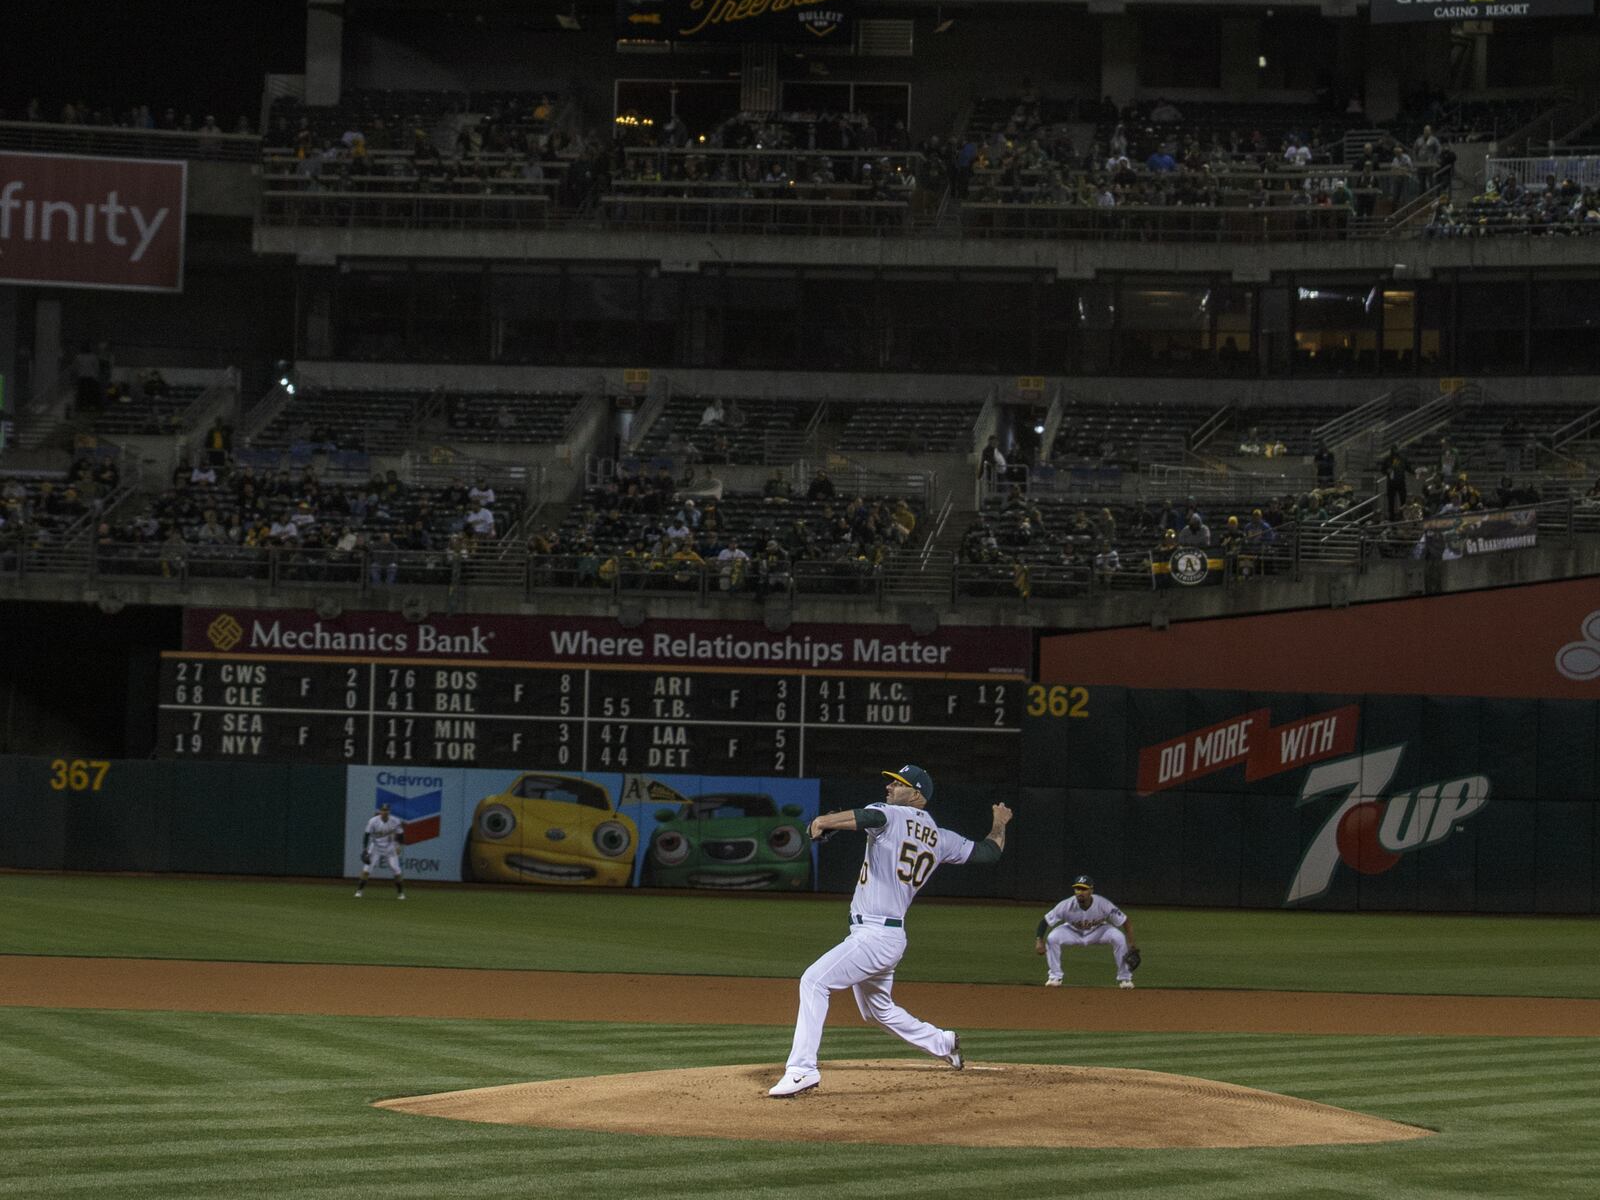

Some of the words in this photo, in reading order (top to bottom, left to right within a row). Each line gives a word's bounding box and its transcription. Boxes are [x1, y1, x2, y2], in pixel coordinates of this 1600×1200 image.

[798, 10, 844, 22] BULLEIT
[1433, 5, 1479, 18] CASINO
[1485, 3, 1530, 16] RESORT
[250, 619, 408, 652] Mechanics
[416, 624, 490, 654] Bank
[550, 629, 645, 657] Where
[653, 632, 843, 668] Relationships
[853, 638, 951, 665] Matter
[220, 665, 267, 683] CWS
[347, 668, 357, 687] 2
[301, 678, 311, 696] F
[435, 670, 478, 690] BOS
[560, 674, 570, 693] 8
[225, 686, 263, 706] CLE
[346, 690, 357, 709] 0
[514, 684, 524, 702] F
[654, 676, 692, 696] ARI
[777, 680, 787, 699] 3
[730, 689, 740, 708] F
[869, 682, 907, 701] K.C.
[435, 693, 476, 712] BAL
[560, 696, 570, 715] 5
[652, 699, 691, 718] T.B.
[776, 702, 786, 721] 6
[947, 695, 957, 714] F
[1026, 684, 1089, 718] 362
[192, 712, 202, 731] 7
[223, 714, 263, 732] SEA
[344, 717, 355, 735] 4
[866, 704, 911, 723] HOU
[994, 707, 1005, 726] 2
[298, 727, 308, 746] F
[434, 720, 476, 739] MIN
[559, 723, 569, 742] 3
[652, 726, 687, 745] LAA
[775, 729, 786, 748] 5
[222, 736, 263, 754] NYY
[344, 739, 354, 758] 5
[434, 742, 476, 760] TOR
[558, 745, 569, 764] 0
[512, 733, 522, 752] F
[728, 739, 738, 758] F
[1158, 742, 1187, 783] DO
[1192, 719, 1253, 772] MORE
[1280, 716, 1337, 765] WITH
[650, 748, 691, 767] DET
[774, 752, 785, 770] 2
[50, 759, 112, 791] 367
[376, 771, 444, 788] Chevron
[373, 855, 440, 872] EHRON
[897, 841, 935, 887] 50
